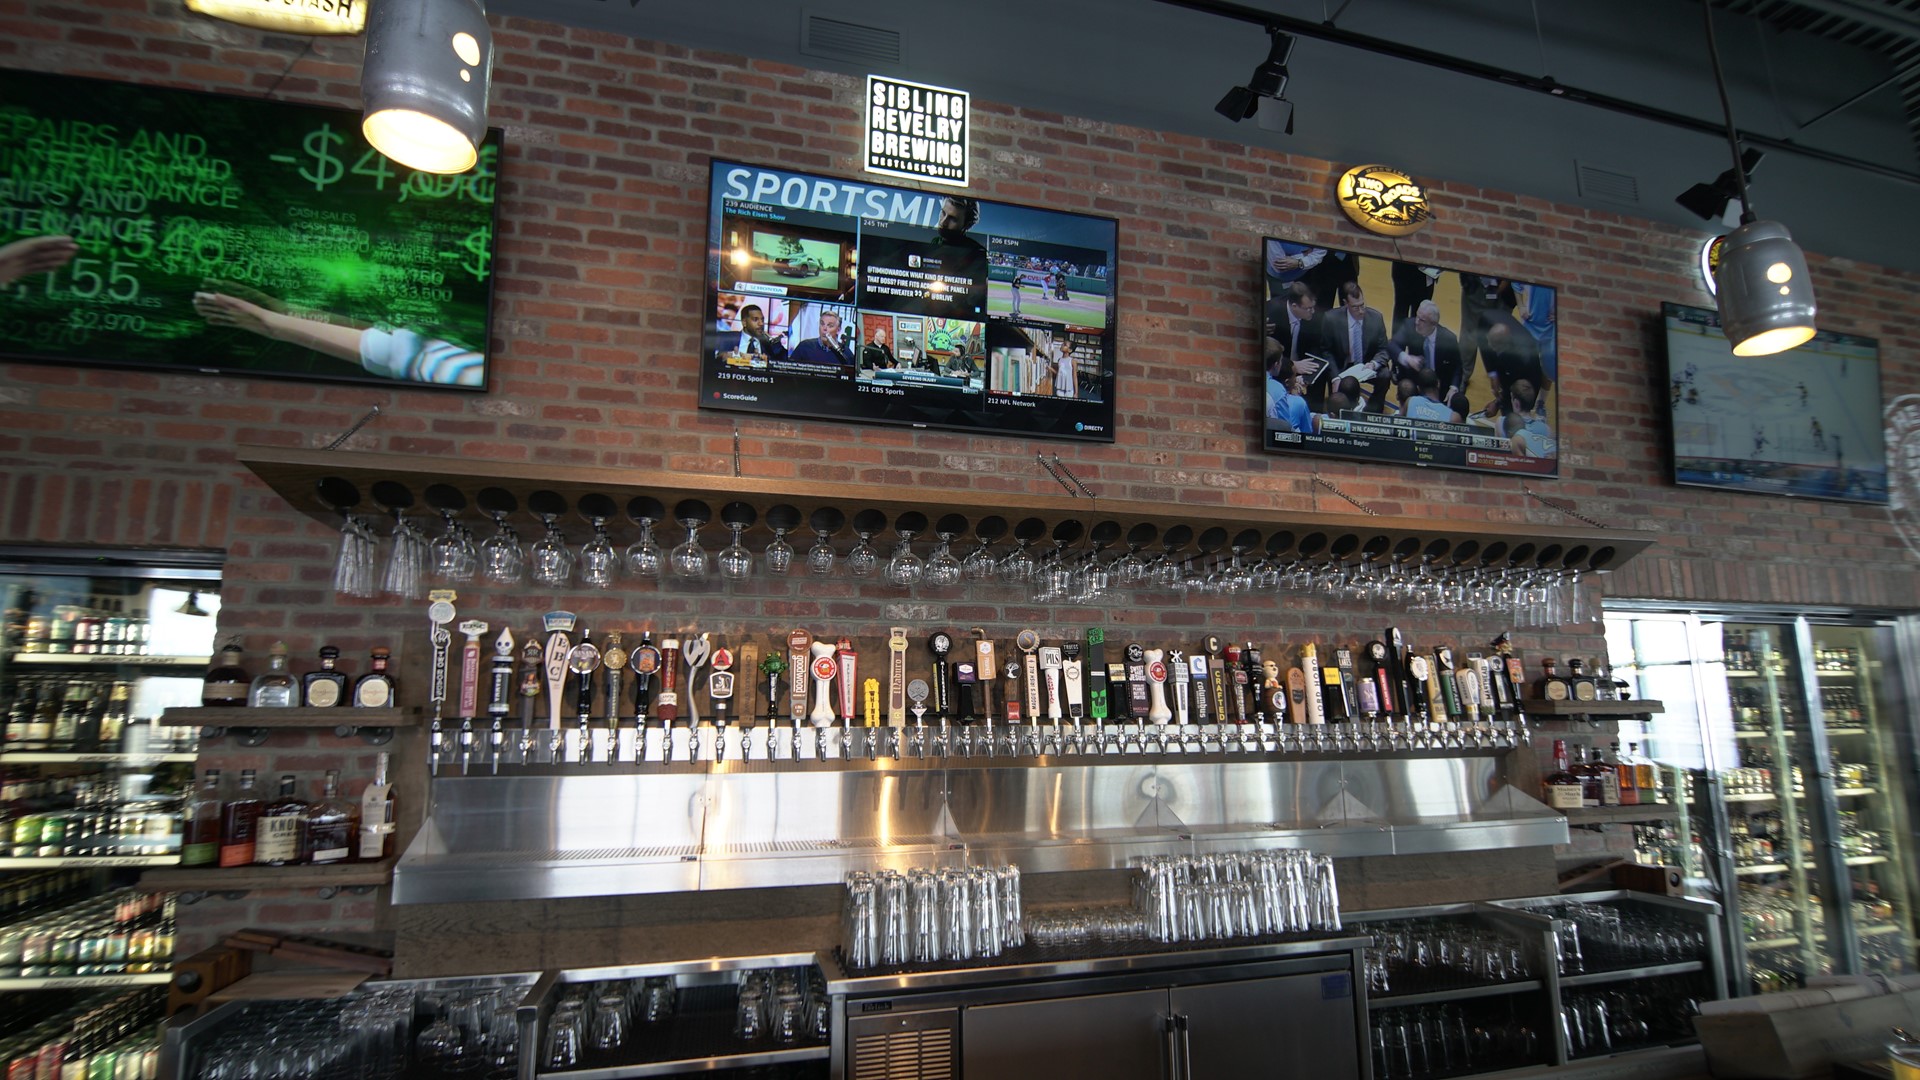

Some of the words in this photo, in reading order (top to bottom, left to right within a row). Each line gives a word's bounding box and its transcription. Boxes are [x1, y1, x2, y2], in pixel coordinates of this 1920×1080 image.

[872, 82, 963, 119] SIBLING
[872, 105, 962, 142] REVELRY
[871, 130, 962, 166] BREWING
[1358, 177, 1384, 191] TWO
[1382, 185, 1420, 205] ROADS
[725, 200, 739, 208] 239
[740, 202, 773, 212] AUDIENCE
[725, 207, 737, 216] The
[738, 208, 751, 217] Rich
[752, 210, 768, 219] Eisen
[769, 213, 786, 222] Show
[863, 219, 876, 227] 245
[877, 221, 889, 229] TNT
[1004, 238, 1019, 247] ESPN
[867, 275, 879, 283] THAT
[951, 285, 965, 294] PANEL
[910, 271, 924, 280] WHAT
[924, 272, 937, 281] KIND
[944, 275, 967, 285] SWEATER
[756, 285, 783, 293] HONDA
[867, 285, 877, 293] BUT
[878, 286, 891, 295] THAT
[891, 287, 914, 297] SWEATER
[718, 372, 731, 380] 219
[732, 373, 746, 381] FOX
[747, 375, 768, 383] Sports
[723, 392, 758, 402] ScoreGuide
[858, 385, 869, 393] 221
[871, 386, 884, 394] CBS
[885, 387, 905, 396] Sports
[987, 397, 999, 405] 212
[1000, 398, 1011, 406] NFL
[1012, 400, 1036, 408] Network
[1367, 415, 1381, 423] NEXT
[1382, 416, 1391, 424] ON
[1393, 417, 1412, 426] ESPN
[1084, 424, 1104, 432] DIRECTV
[1323, 421, 1346, 431] ESPN
[1363, 427, 1391, 435] CAROLINA
[1397, 429, 1407, 437] 70
[1460, 436, 1470, 444] 73
[1353, 439, 1370, 447] Baylor
[1210, 637, 1218, 651] C
[1045, 653, 1060, 665] PILS
[791, 655, 807, 693] goodwood
[893, 659, 901, 694] Maduro
[1311, 659, 1320, 686] HOBO
[1481, 666, 1491, 700] MASTHEAD
[1197, 681, 1207, 718] columbus
[1215, 671, 1226, 720] CRAFTED
[1315, 692, 1324, 717] LORD
[270, 818, 300, 832] KNO
